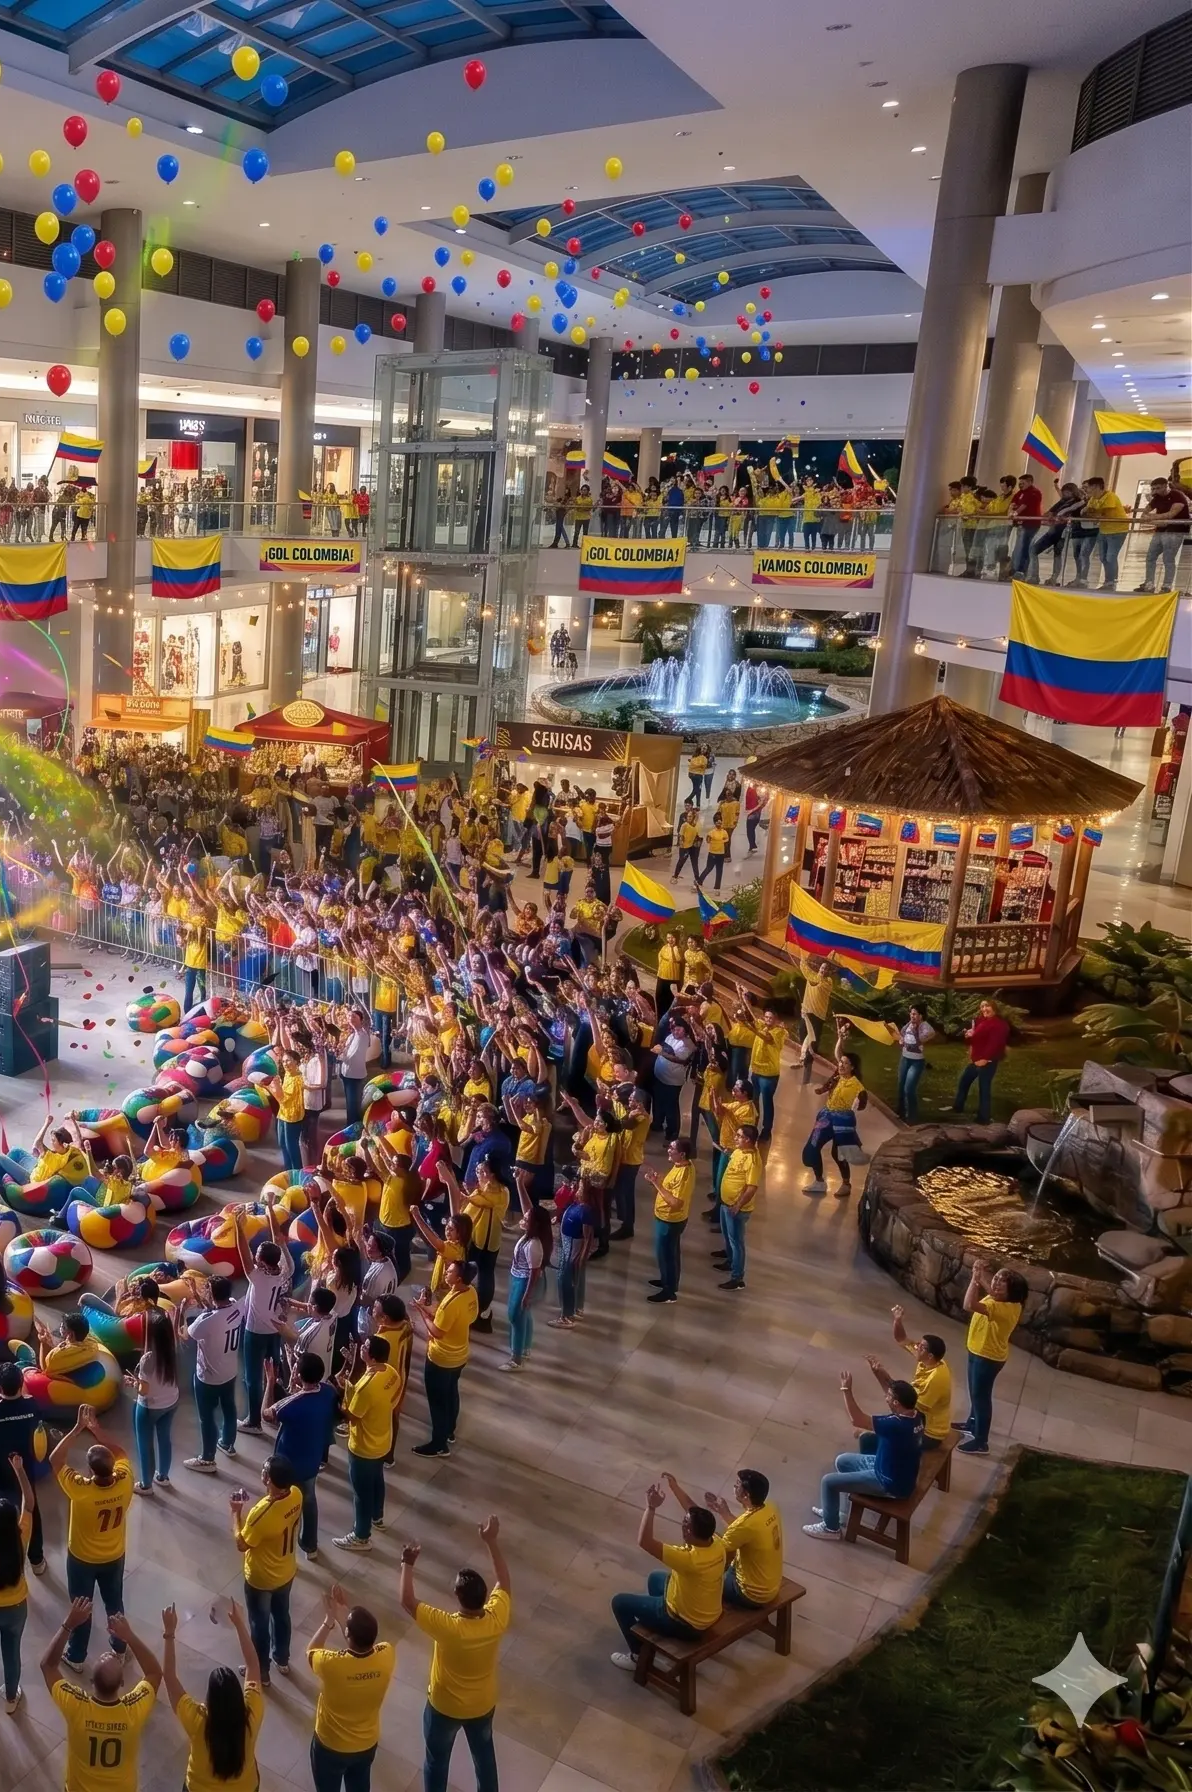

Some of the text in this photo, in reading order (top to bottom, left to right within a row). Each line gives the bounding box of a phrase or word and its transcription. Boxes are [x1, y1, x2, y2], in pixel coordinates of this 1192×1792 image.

[265, 547, 354, 562] ¡GOL COLOMBIA!
[586, 546, 679, 562] ¡GOL COLOMBIA!
[757, 558, 868, 576] ¡VAMOS COLOMBIA!
[224, 1326, 240, 1354] 10
[88, 1736, 122, 1768] 10
